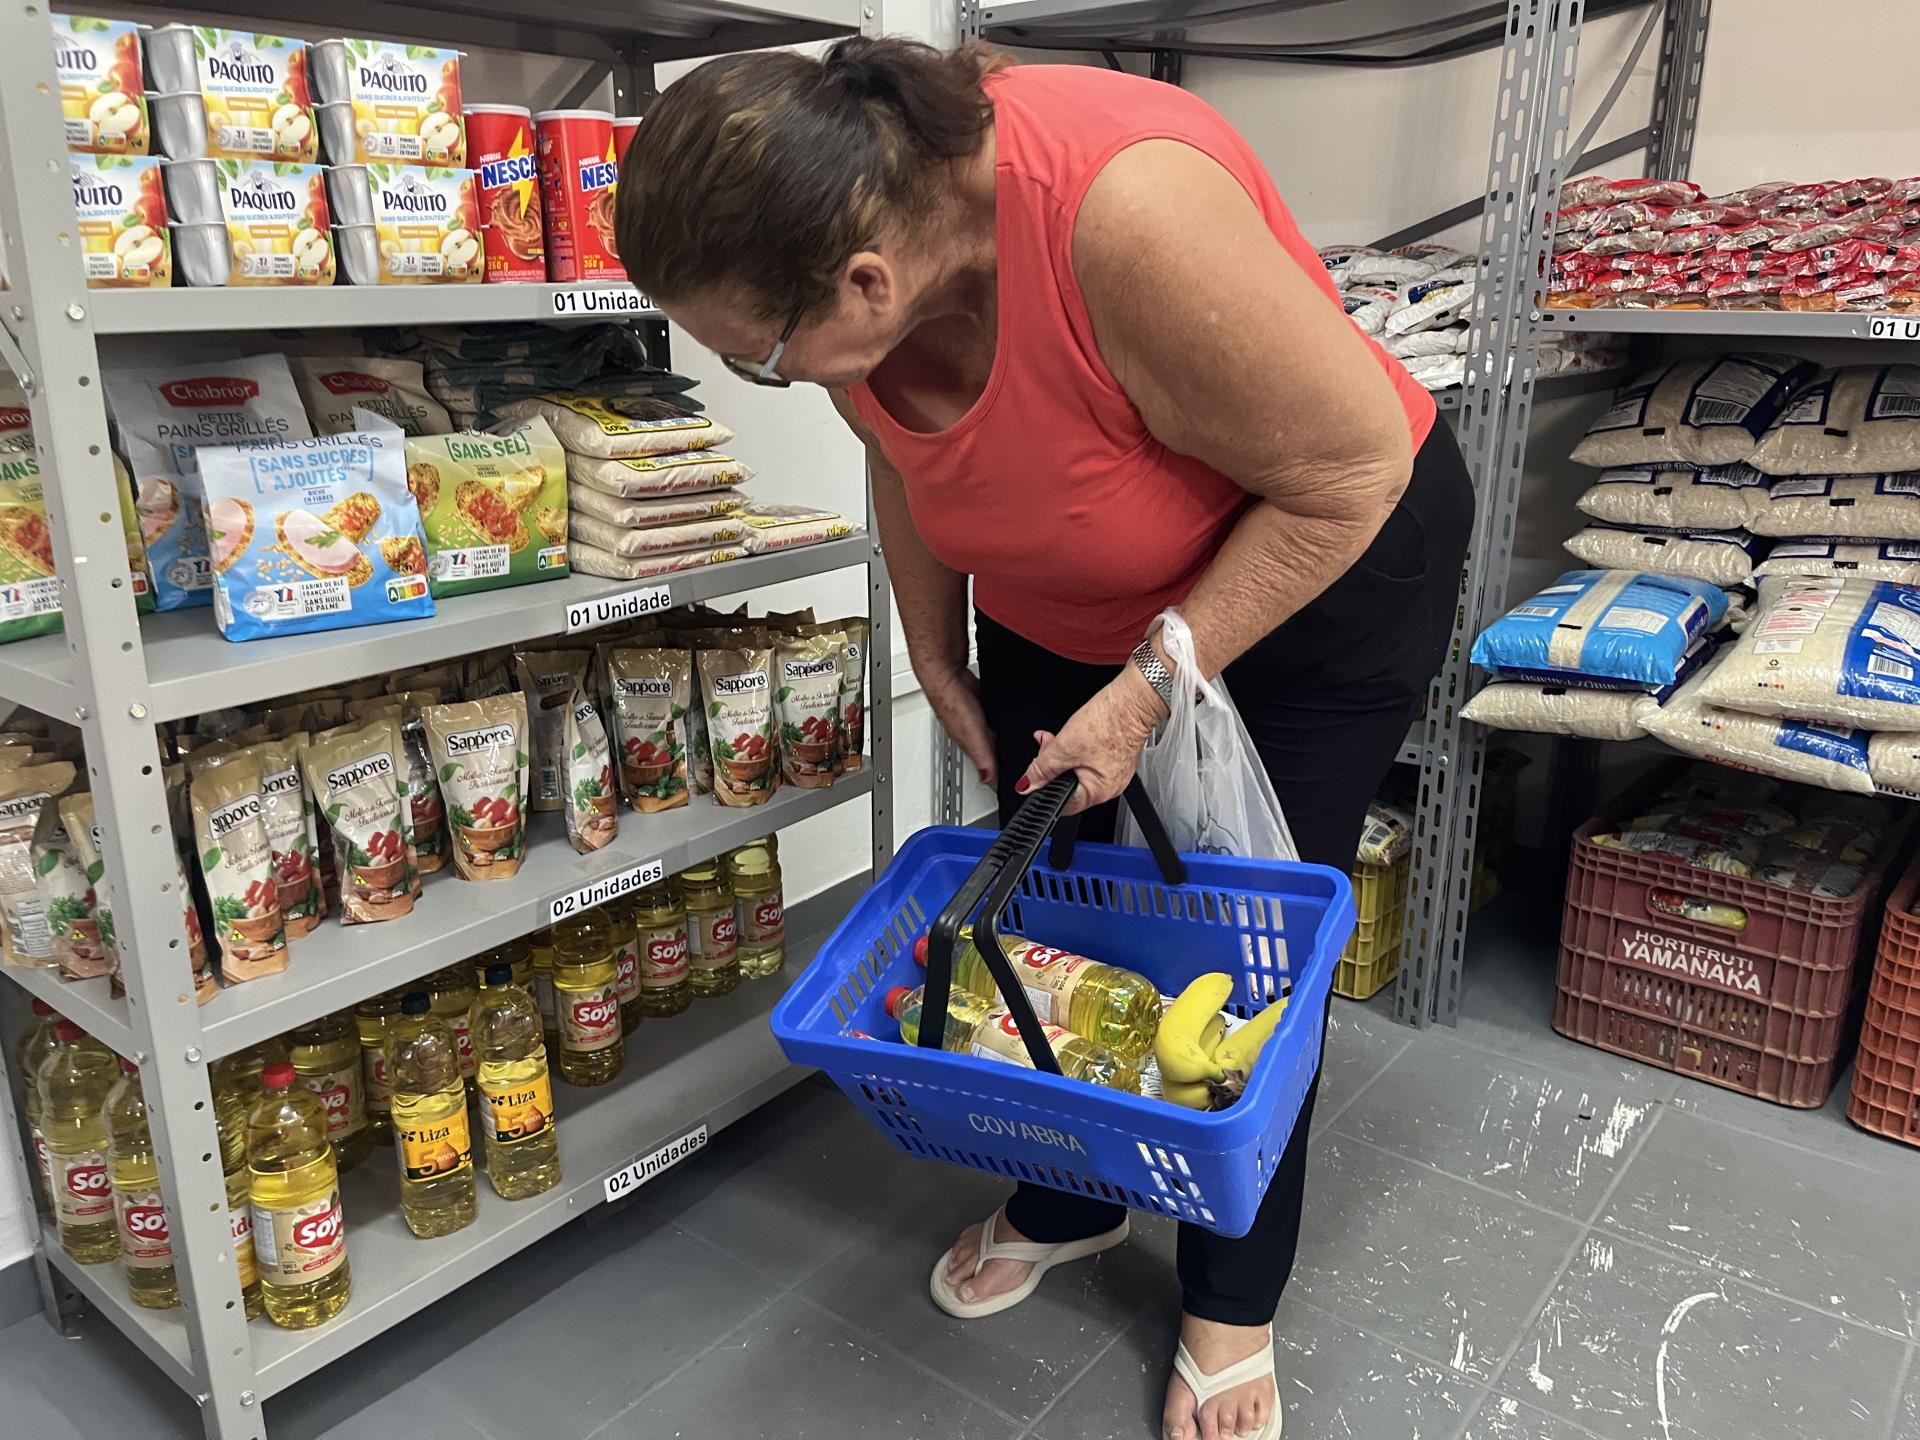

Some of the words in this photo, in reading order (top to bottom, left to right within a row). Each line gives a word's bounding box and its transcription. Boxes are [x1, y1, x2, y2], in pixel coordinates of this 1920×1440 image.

[209, 57, 274, 84] PAQUITO
[360, 67, 428, 93] PAQUITO
[231, 188, 296, 212] PAQUITO
[382, 190, 447, 212] PAQUITO
[554, 293, 576, 312] 01
[1872, 320, 1896, 337] 01
[171, 380, 252, 400] Chabrior
[157, 424, 212, 438] PAINS
[216, 416, 289, 437] GRILLÉS
[198, 412, 245, 423] PETITS
[0, 458, 40, 480] ANS
[302, 582, 323, 590] FARINE
[304, 597, 324, 606] SANS
[324, 595, 345, 603] HUILE
[316, 602, 339, 612] PALME
[570, 607, 590, 627] 01
[597, 592, 670, 620] Unidade
[785, 660, 834, 678] Sappore
[617, 678, 670, 696] Sappore
[716, 675, 766, 693] Sappore
[448, 729, 512, 752] Sappore
[328, 757, 390, 791] Sappore
[554, 896, 574, 917] 02
[580, 866, 661, 906] Unidades
[1030, 948, 1062, 966] So
[1636, 930, 1754, 972] HORTIFRUTI
[1622, 938, 1762, 996] YAMANAKA
[578, 1000, 618, 1022] Soya
[508, 1090, 536, 1107] Liza
[420, 1126, 450, 1144] Liza
[968, 1112, 1088, 1156] COVABRA
[608, 1172, 631, 1193] 02
[632, 1132, 706, 1180] Unidades
